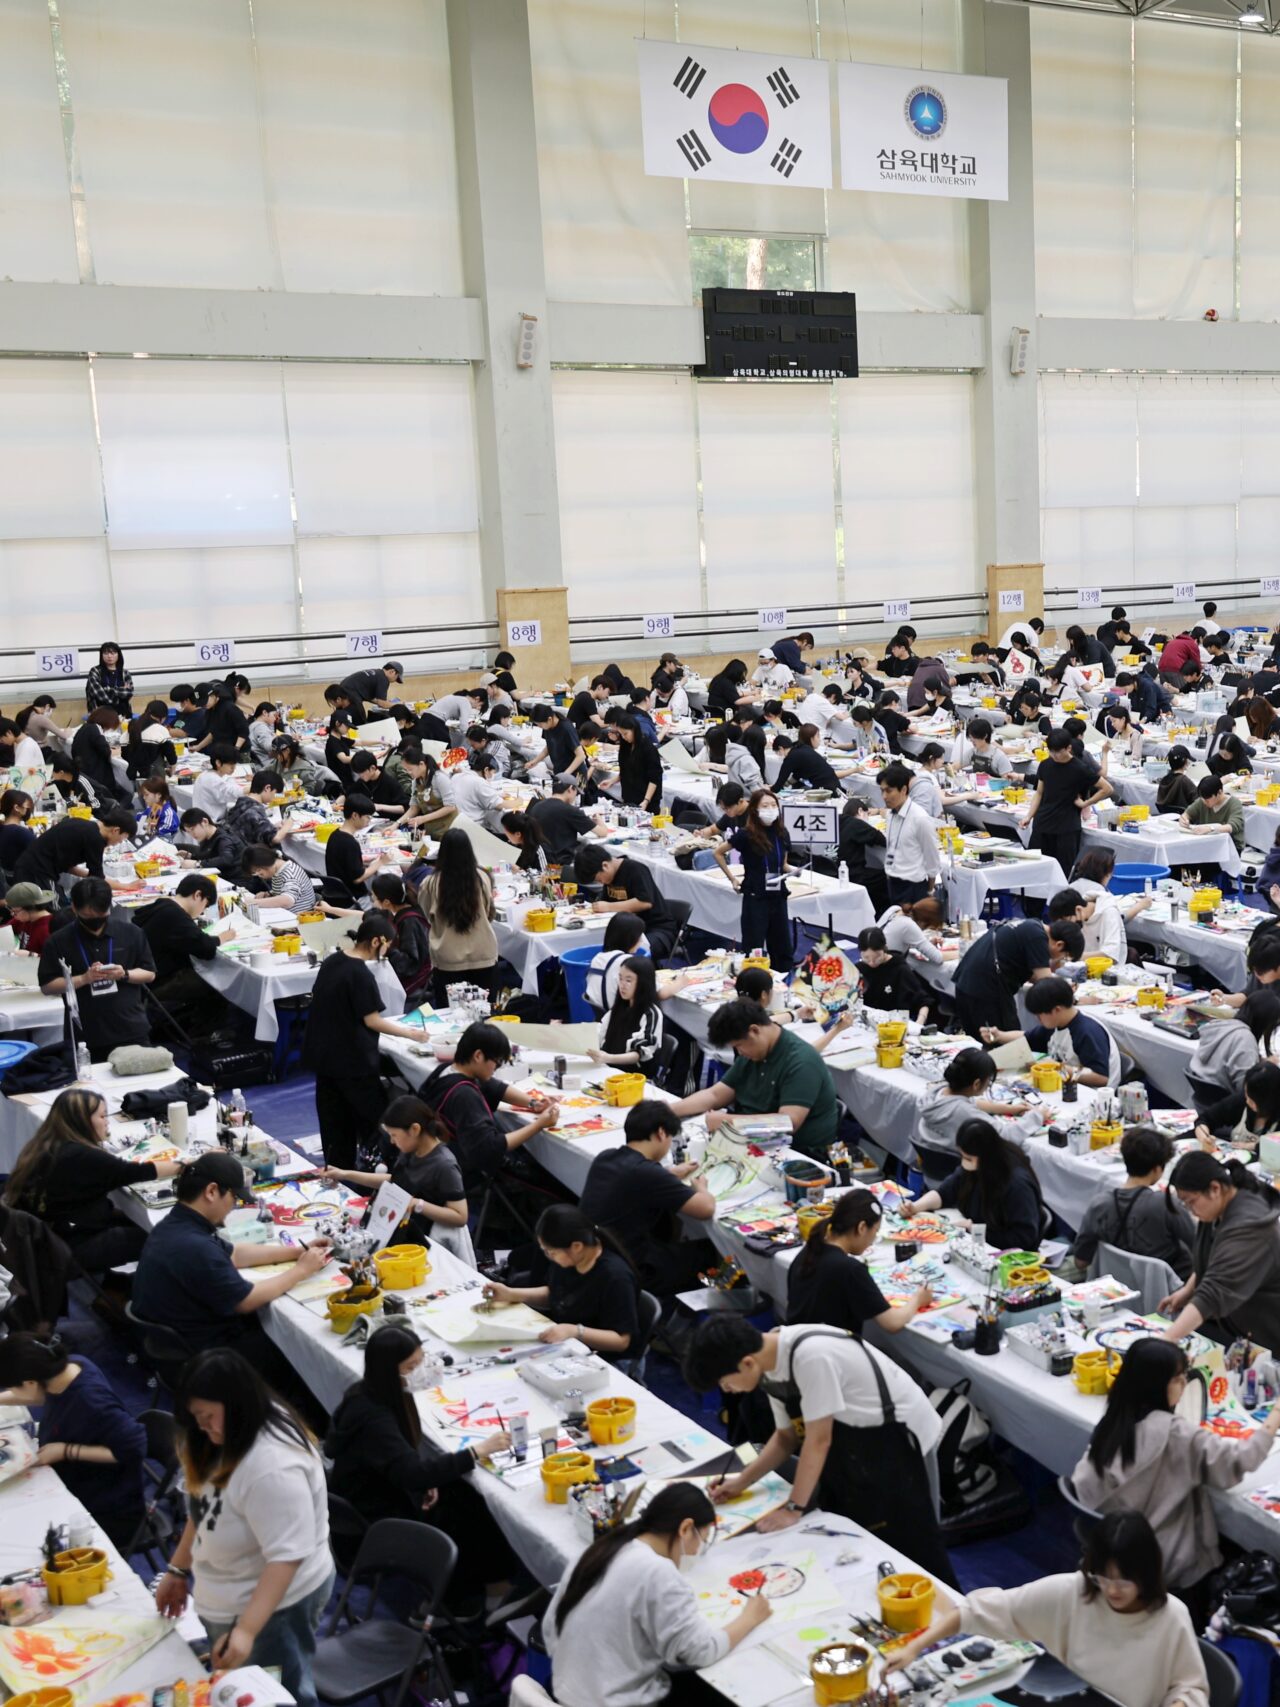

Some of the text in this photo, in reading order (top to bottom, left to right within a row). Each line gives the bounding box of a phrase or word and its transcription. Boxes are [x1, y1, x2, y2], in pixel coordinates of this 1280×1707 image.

[877, 149, 977, 175] 삼육대학교
[880, 171, 977, 187] SAHMYOOK UNIVERSITY
[1176, 585, 1194, 598] 14행
[1263, 579, 1280, 591] 15행
[1002, 593, 1022, 606] 12행
[1081, 590, 1099, 603] 13행
[762, 611, 784, 625] 10행
[887, 603, 908, 616] 11행
[511, 624, 537, 643] 8행
[647, 617, 670, 635] 9행
[200, 643, 230, 662] 6행
[350, 635, 378, 653] 7행
[42, 653, 73, 673] 5행
[793, 814, 827, 832] 4조
